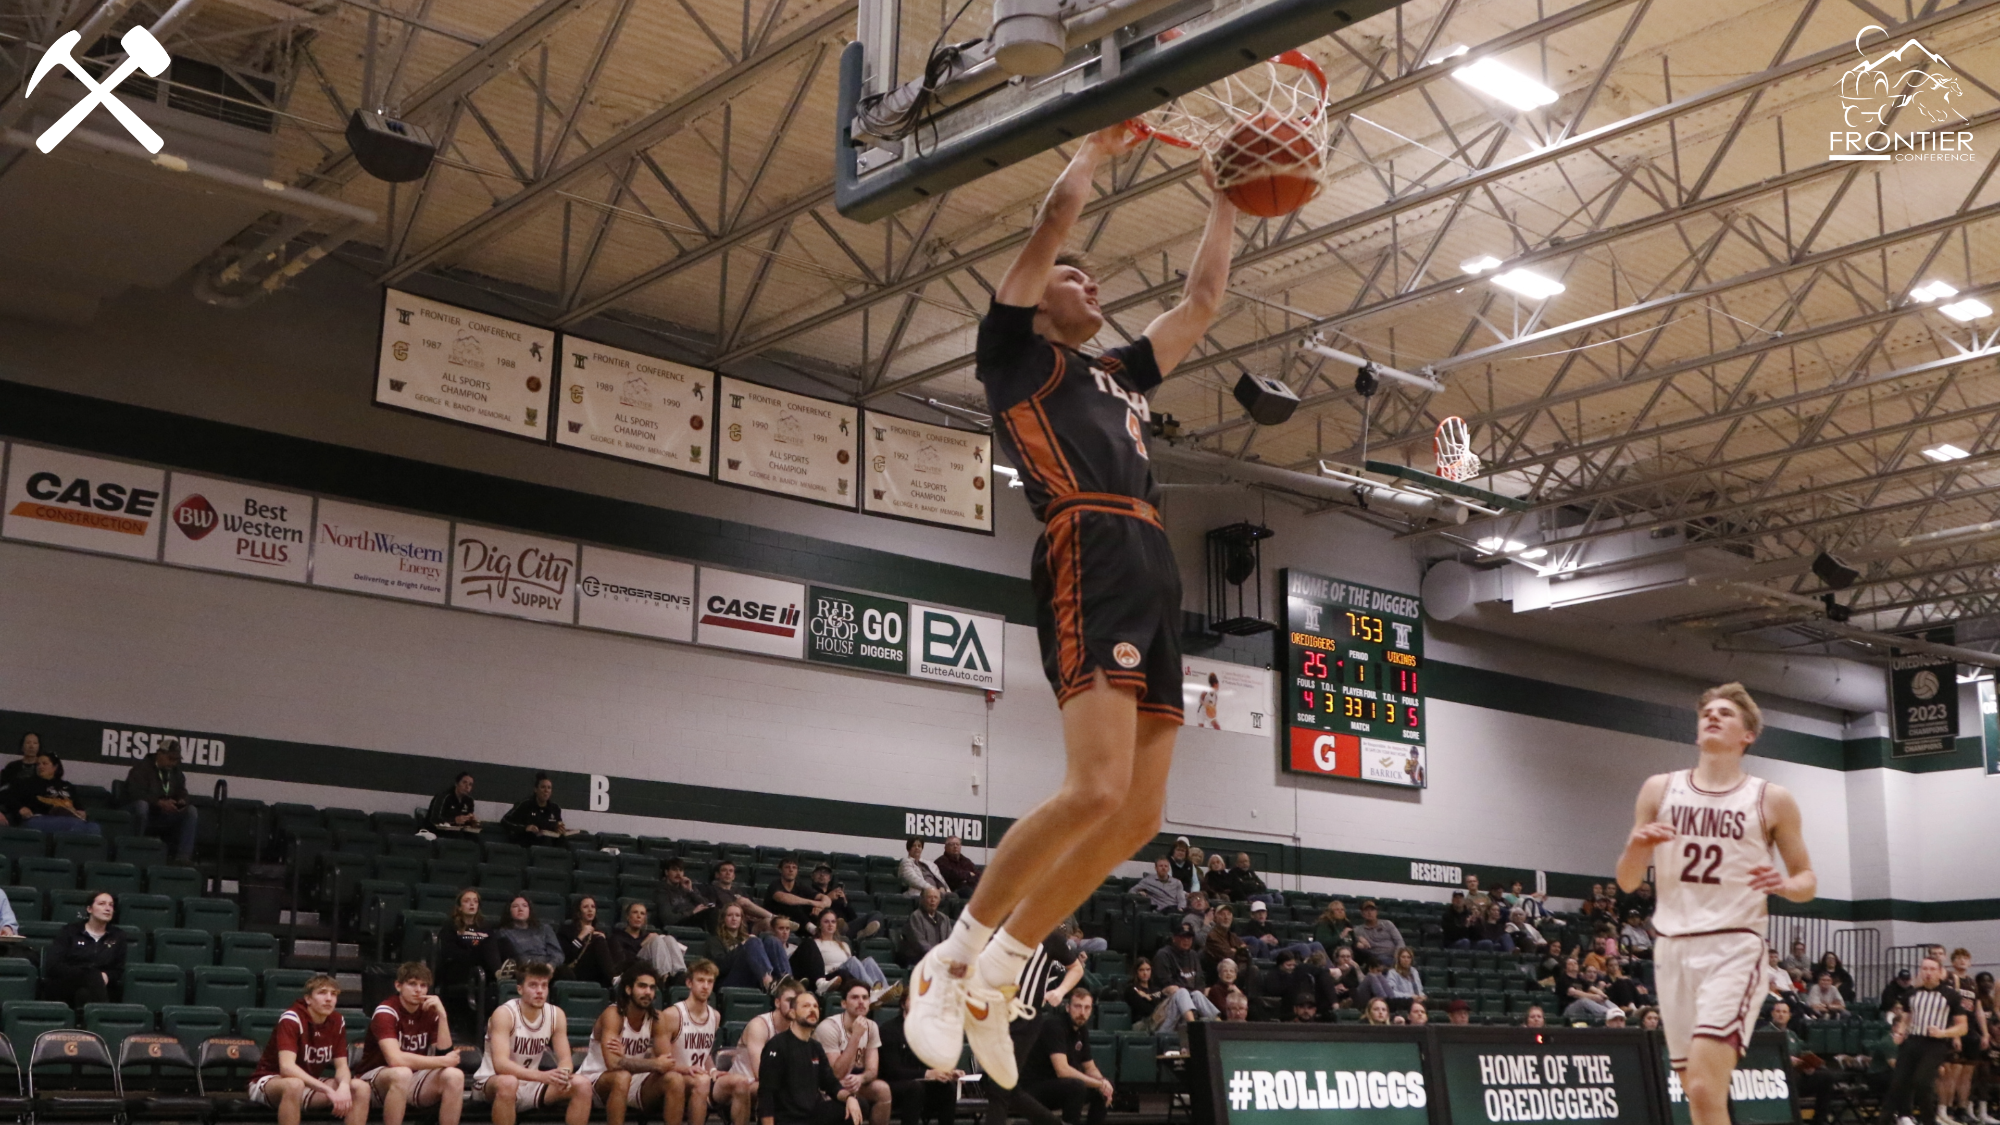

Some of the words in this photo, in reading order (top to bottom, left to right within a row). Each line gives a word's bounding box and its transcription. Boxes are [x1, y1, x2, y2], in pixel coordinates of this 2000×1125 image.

[420, 308, 461, 326] FRONTIER
[468, 321, 522, 342] CONFERENCE
[422, 338, 442, 350] 1987
[497, 357, 516, 369] 1988
[593, 352, 630, 368] FRONTIER
[636, 363, 685, 383] CONFERENCE
[442, 372, 457, 383] ALL
[459, 376, 491, 391] SPORTS
[596, 381, 614, 392] 1989
[415, 393, 441, 405] GEORGE
[440, 384, 488, 402] CHAMPION
[663, 397, 681, 408] 1990
[748, 392, 782, 407] FRONTIER
[787, 402, 832, 419] CONFERENCE
[615, 413, 628, 423] ALL
[630, 416, 659, 430] SPORTS
[752, 420, 769, 430] 1990
[590, 434, 614, 445] GEORGE
[614, 424, 656, 441] CHAMPION
[813, 433, 828, 443] 1991
[890, 425, 921, 438] FRONTIER
[926, 433, 967, 447] CONFERENCE
[769, 450, 782, 460] ALL
[783, 452, 810, 465] SPORTS
[893, 451, 909, 461] 1992
[768, 461, 807, 475] CHAMPION
[950, 462, 964, 472] 1993
[25, 472, 159, 518] CASE
[911, 479, 922, 488] ALL
[924, 481, 948, 493] SPORTS
[911, 489, 946, 503] CHAMPION
[244, 498, 288, 521] Best
[893, 499, 913, 509] GEORGE
[35, 506, 143, 533] CONSTRUCTION
[223, 514, 304, 544] Western
[236, 538, 288, 562] PLUS
[320, 523, 443, 562] NorthWestern
[399, 557, 442, 581] Energy
[458, 538, 512, 598] Dig
[517, 548, 573, 594] City
[354, 573, 389, 586] Delivering
[397, 580, 418, 590] Bright
[419, 583, 441, 593] Future
[601, 583, 690, 606] TORGERSON'S
[603, 594, 690, 612] EQUIPMENT
[1292, 574, 1328, 599] HOME
[1330, 582, 1346, 603] OF
[1348, 585, 1371, 608] THE
[1371, 591, 1420, 619] DIGGERS
[707, 595, 777, 622] CASE
[817, 598, 855, 622] RIB
[810, 616, 858, 641] CHOP
[862, 608, 903, 644] GO
[1346, 612, 1383, 643] 7:53
[815, 636, 854, 655] HOUSE
[1291, 632, 1336, 652] OREDIGGERS
[860, 644, 903, 662] DIGGERS
[1348, 650, 1369, 661] PERIOD
[1387, 650, 1417, 667] VIKINGS
[920, 664, 993, 683] ButteAuto.com
[1304, 650, 1328, 679] 25
[1359, 665, 1364, 682] 1
[1297, 677, 1316, 689] FOULS
[1401, 670, 1417, 694] 11
[1303, 690, 1314, 709] 4
[1342, 685, 1364, 698] PLAYER
[1363, 689, 1378, 700] FOUL
[1401, 696, 1419, 707] FOULS
[1325, 693, 1334, 713] 3
[1345, 696, 1362, 718] 33
[1371, 702, 1376, 719] 1
[1386, 703, 1395, 723] 3
[1908, 703, 1948, 723] 2023
[1297, 712, 1316, 724] SCORE
[1350, 721, 1370, 732] MATCH
[1408, 707, 1418, 727] 5
[1402, 729, 1420, 740] SCORE
[101, 728, 226, 767] RESEVED
[1370, 767, 1403, 780] BARRICK
[589, 774, 610, 812] B
[905, 812, 982, 841] RESERVED
[1671, 805, 1746, 840] VIKINGS
[1410, 861, 1462, 885] RESERVED
[1680, 842, 1723, 885] 22
[1478, 1054, 1541, 1085] HOME
[1543, 1054, 1569, 1085] OF
[1572, 1054, 1615, 1084] THE
[1228, 1070, 1427, 1110] #ROLLDIGGS
[1484, 1087, 1619, 1122] OREDIGGERS
